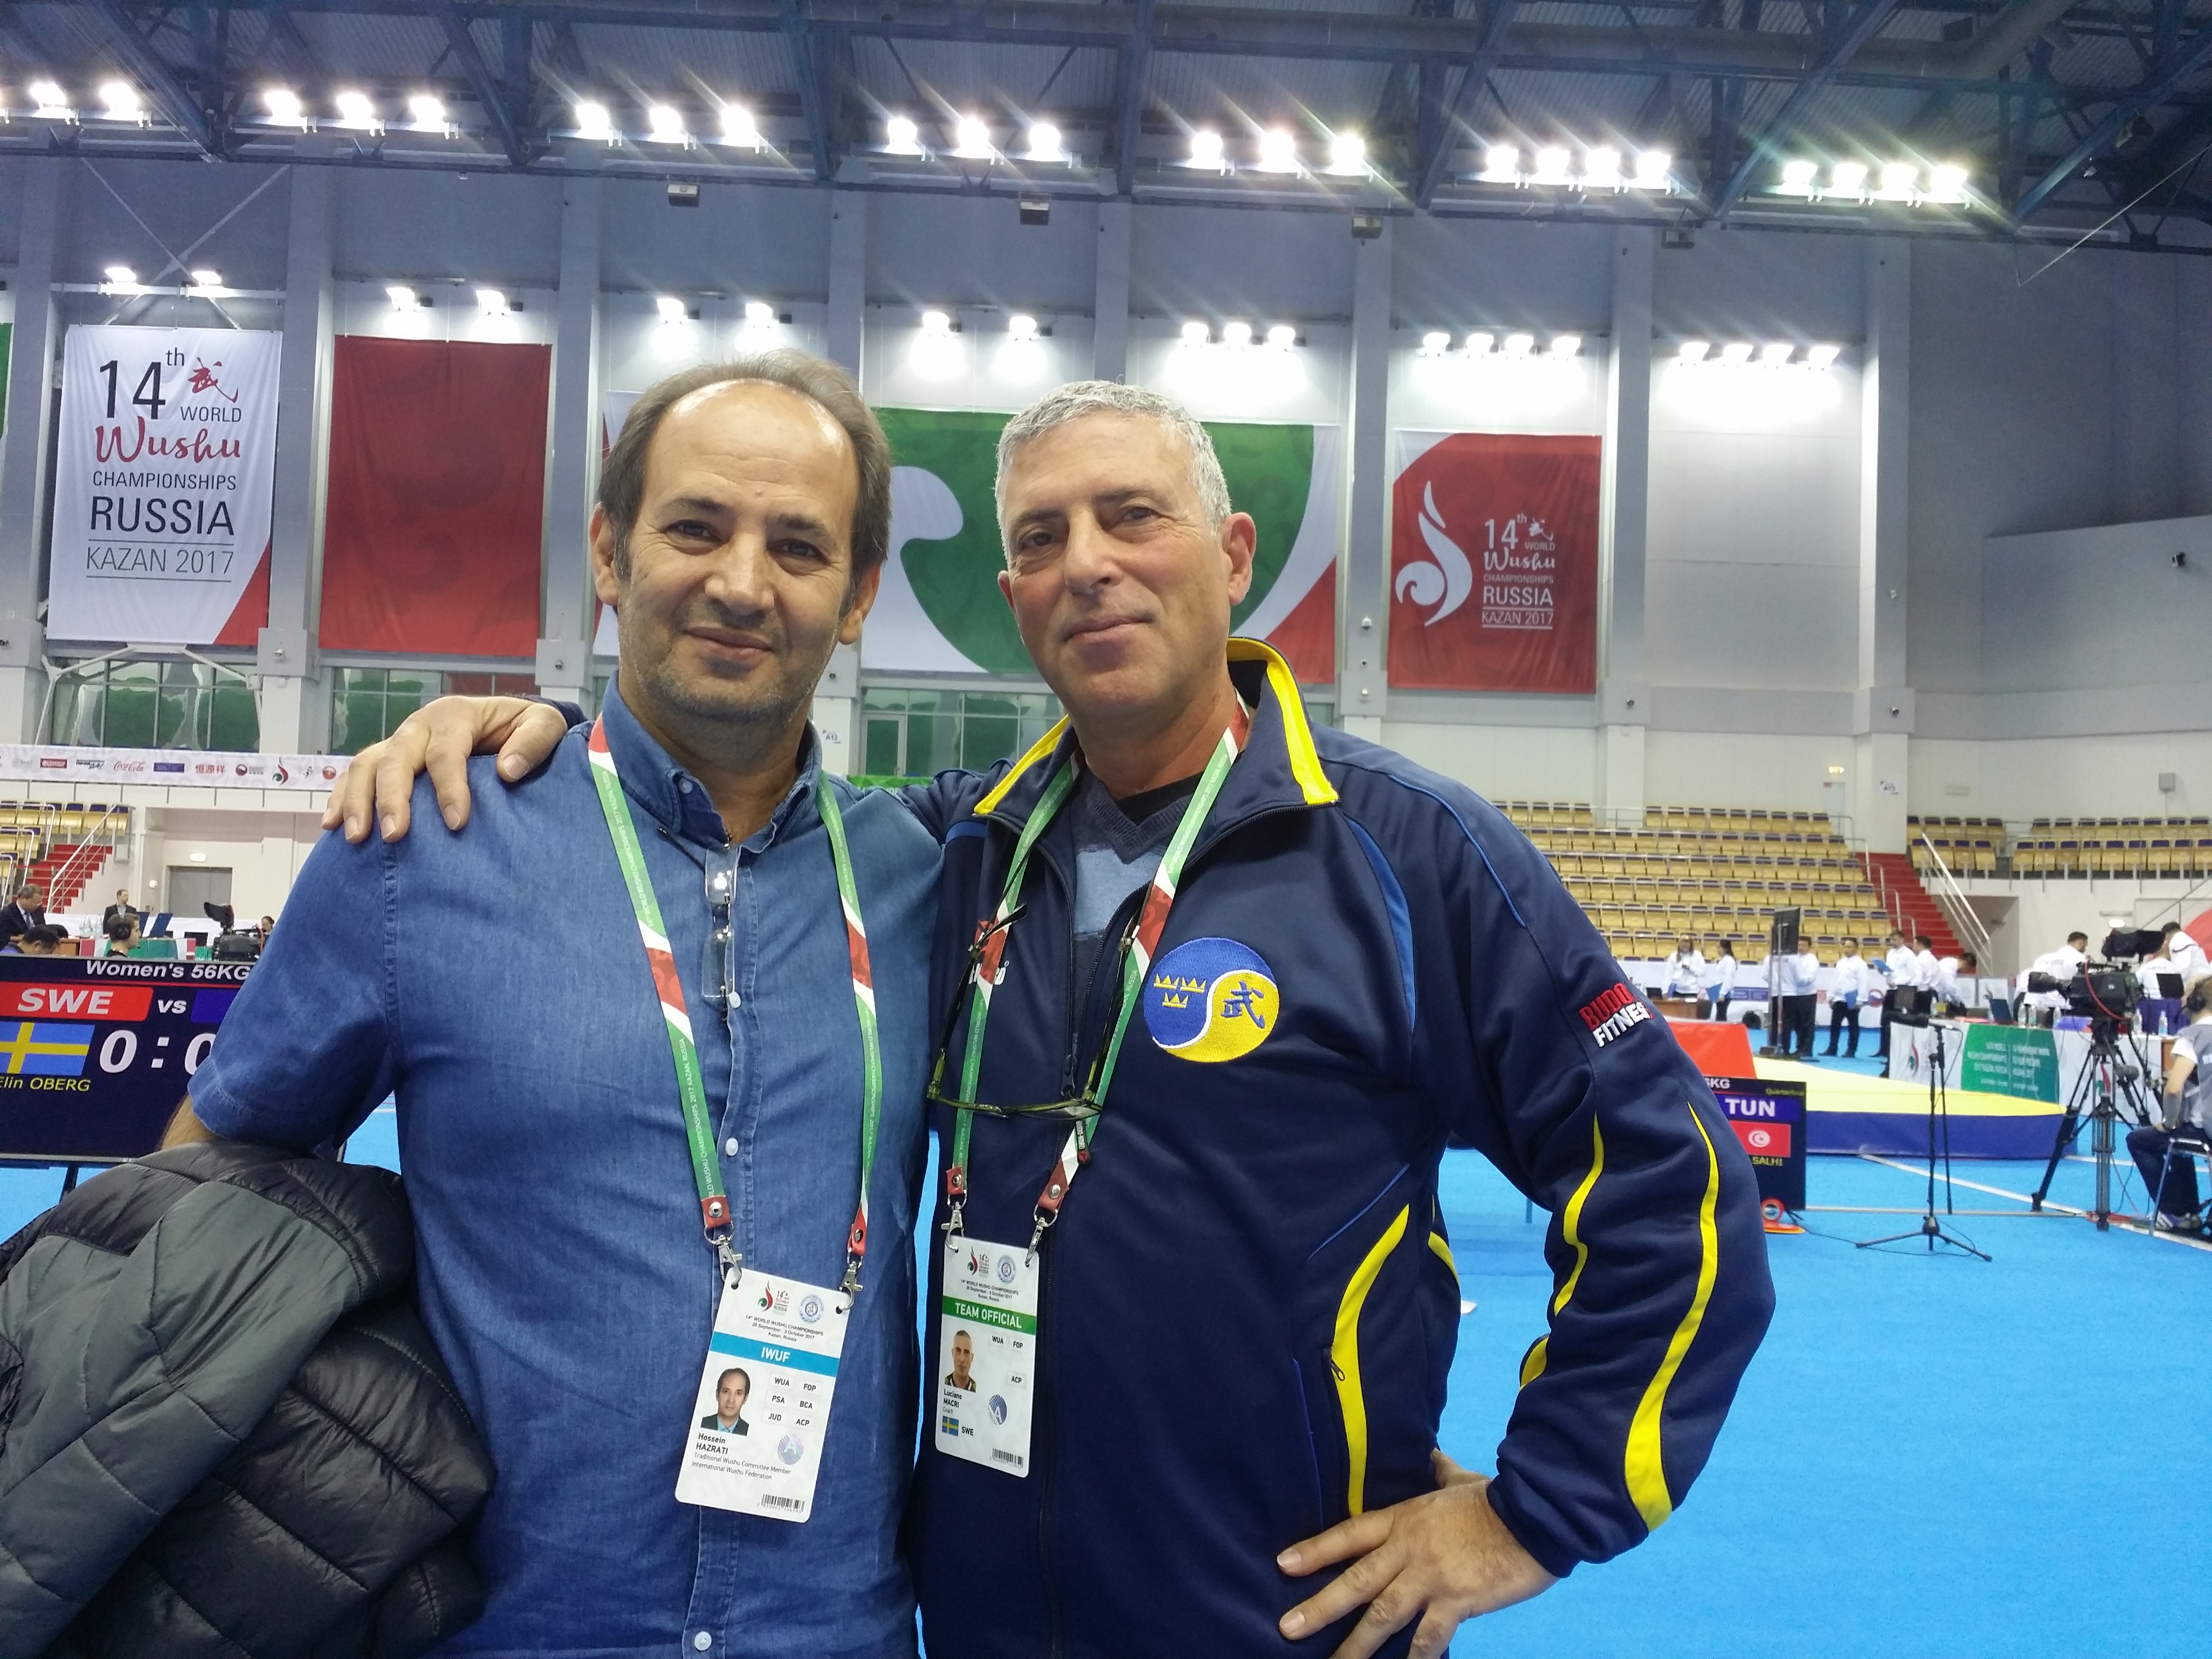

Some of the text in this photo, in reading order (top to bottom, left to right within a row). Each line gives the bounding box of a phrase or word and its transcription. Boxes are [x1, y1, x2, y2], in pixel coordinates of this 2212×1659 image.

[100, 347, 185, 420] 14th
[181, 406, 242, 422] WORLD
[95, 416, 241, 463] Wushu
[93, 470, 236, 490] CHAMPIONSHIPS
[91, 496, 234, 535] RUSSIA
[1525, 541, 1555, 550] WORLD
[87, 547, 234, 573] KAZAN 2017
[1484, 547, 1555, 571] Wushu
[1483, 573, 1553, 584] CHAMPIONSHIPS
[1483, 586, 1553, 606] RUSSIA
[1482, 611, 1553, 625] KAZAN 2017
[601, 769, 612, 789] RUSSIA
[613, 810, 623, 825] 2017
[618, 825, 638, 872] CHAMPIONSHIPS
[632, 870, 644, 894] WUSHU
[639, 892, 651, 915] WORLD
[86, 960, 251, 980] Women's 56KG
[1125, 969, 1138, 992] RUSSIA
[18, 988, 186, 1015] SWE vs
[974, 1011, 983, 1034] WORLD
[99, 1029, 138, 1073] 0
[678, 1037, 690, 1062] RUSSIA
[970, 1034, 978, 1058] WUSHU
[30, 1077, 91, 1092] OBERG
[964, 1058, 975, 1102] CHAMPIONSHI
[687, 1087, 697, 1103] 2017
[865, 1065, 879, 1117] CHAMPIONSHIPS
[1725, 1098, 1775, 1117] TUN
[690, 1104, 708, 1158] CHAMPIONSHIPS
[868, 1118, 876, 1135] 2017
[701, 1158, 713, 1184] WUSHU
[1752, 1156, 1783, 1167] SALHI
[955, 1302, 1022, 1329] TEAM OFFICIAL
[758, 1324, 781, 1332] September
[788, 1330, 804, 1338] October
[771, 1320, 787, 1328] WUSHU
[788, 1325, 824, 1336] CHAMPIONSHIPS
[992, 1335, 1023, 1349] WUA FOP
[761, 1347, 791, 1363] IWUF
[775, 1377, 817, 1392] WUA FOP
[1011, 1376, 1022, 1384] ACP
[772, 1395, 813, 1409] PSA BCA
[943, 1398, 959, 1408] MACRI
[944, 1388, 962, 1400] Luciano
[768, 1413, 782, 1421] JUD
[698, 1432, 726, 1444] Hossein
[961, 1426, 974, 1436] SWE
[696, 1443, 729, 1455] HAZRATI
[692, 1461, 772, 1480] International Wushu Federation
[694, 1452, 791, 1475] Traditional Wushu Committee Member
